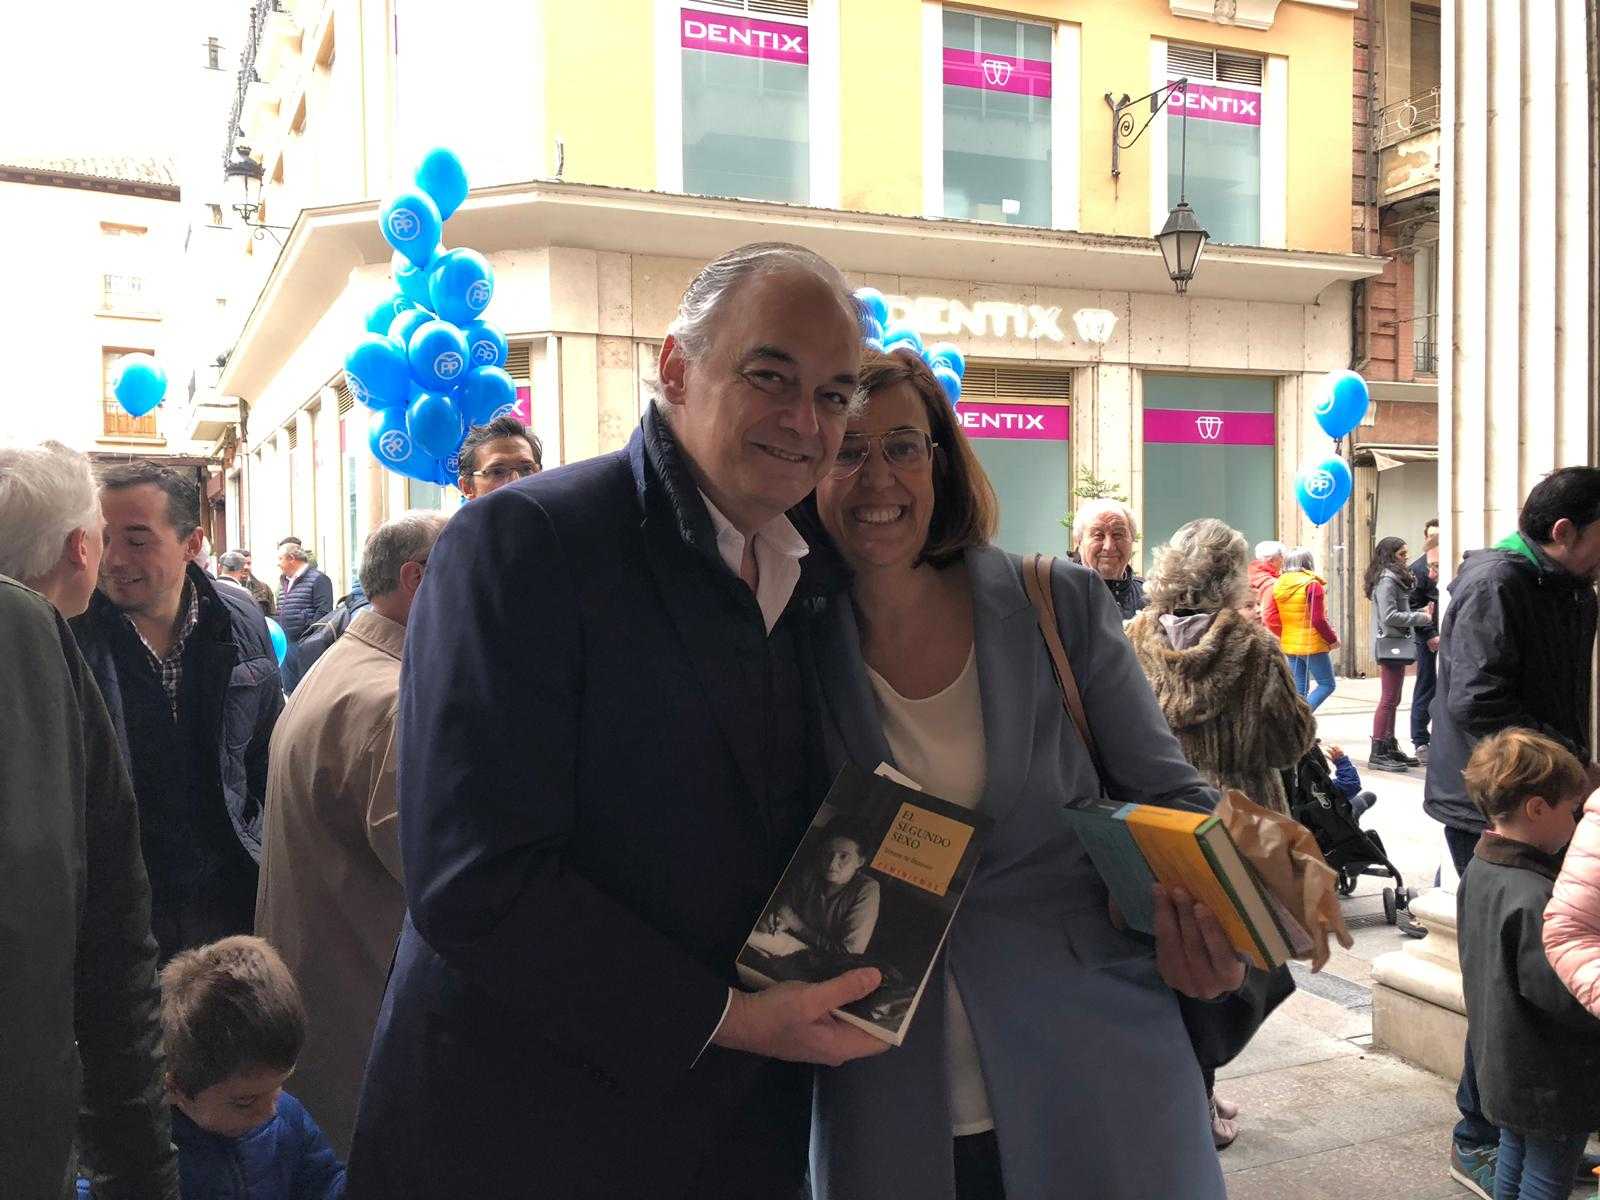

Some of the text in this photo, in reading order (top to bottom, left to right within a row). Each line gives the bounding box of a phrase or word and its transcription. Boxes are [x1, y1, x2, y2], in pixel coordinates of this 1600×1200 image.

[684, 20, 804, 54] DENTIX
[1168, 90, 1257, 116] DENTIX
[885, 294, 1065, 341] DENTIX
[902, 810, 914, 821] EL
[892, 831, 920, 849] SEXO
[896, 821, 951, 848] SEGUNDO
